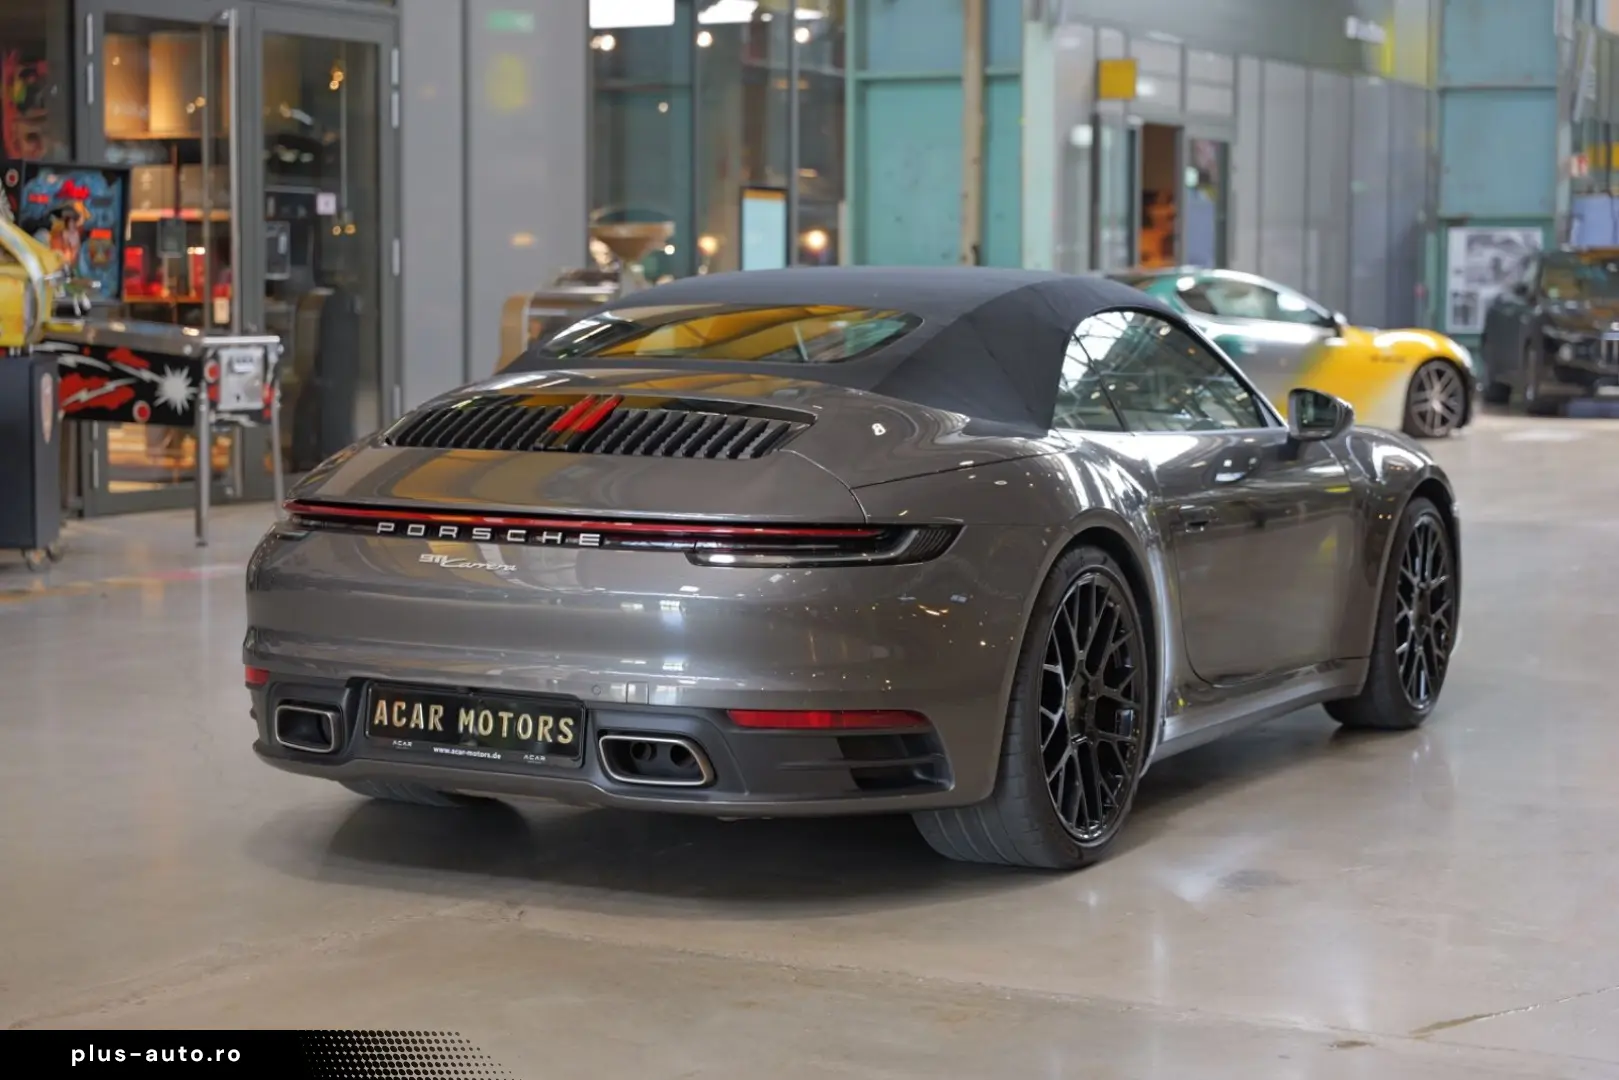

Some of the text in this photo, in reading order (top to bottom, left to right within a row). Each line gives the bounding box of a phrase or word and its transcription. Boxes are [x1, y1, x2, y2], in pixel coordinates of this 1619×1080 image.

[376, 522, 601, 546] PORSCHE
[440, 557, 517, 571] Carrera
[374, 700, 574, 745] ACAR MOTORS
[433, 746, 501, 760] www.acar-motors.de
